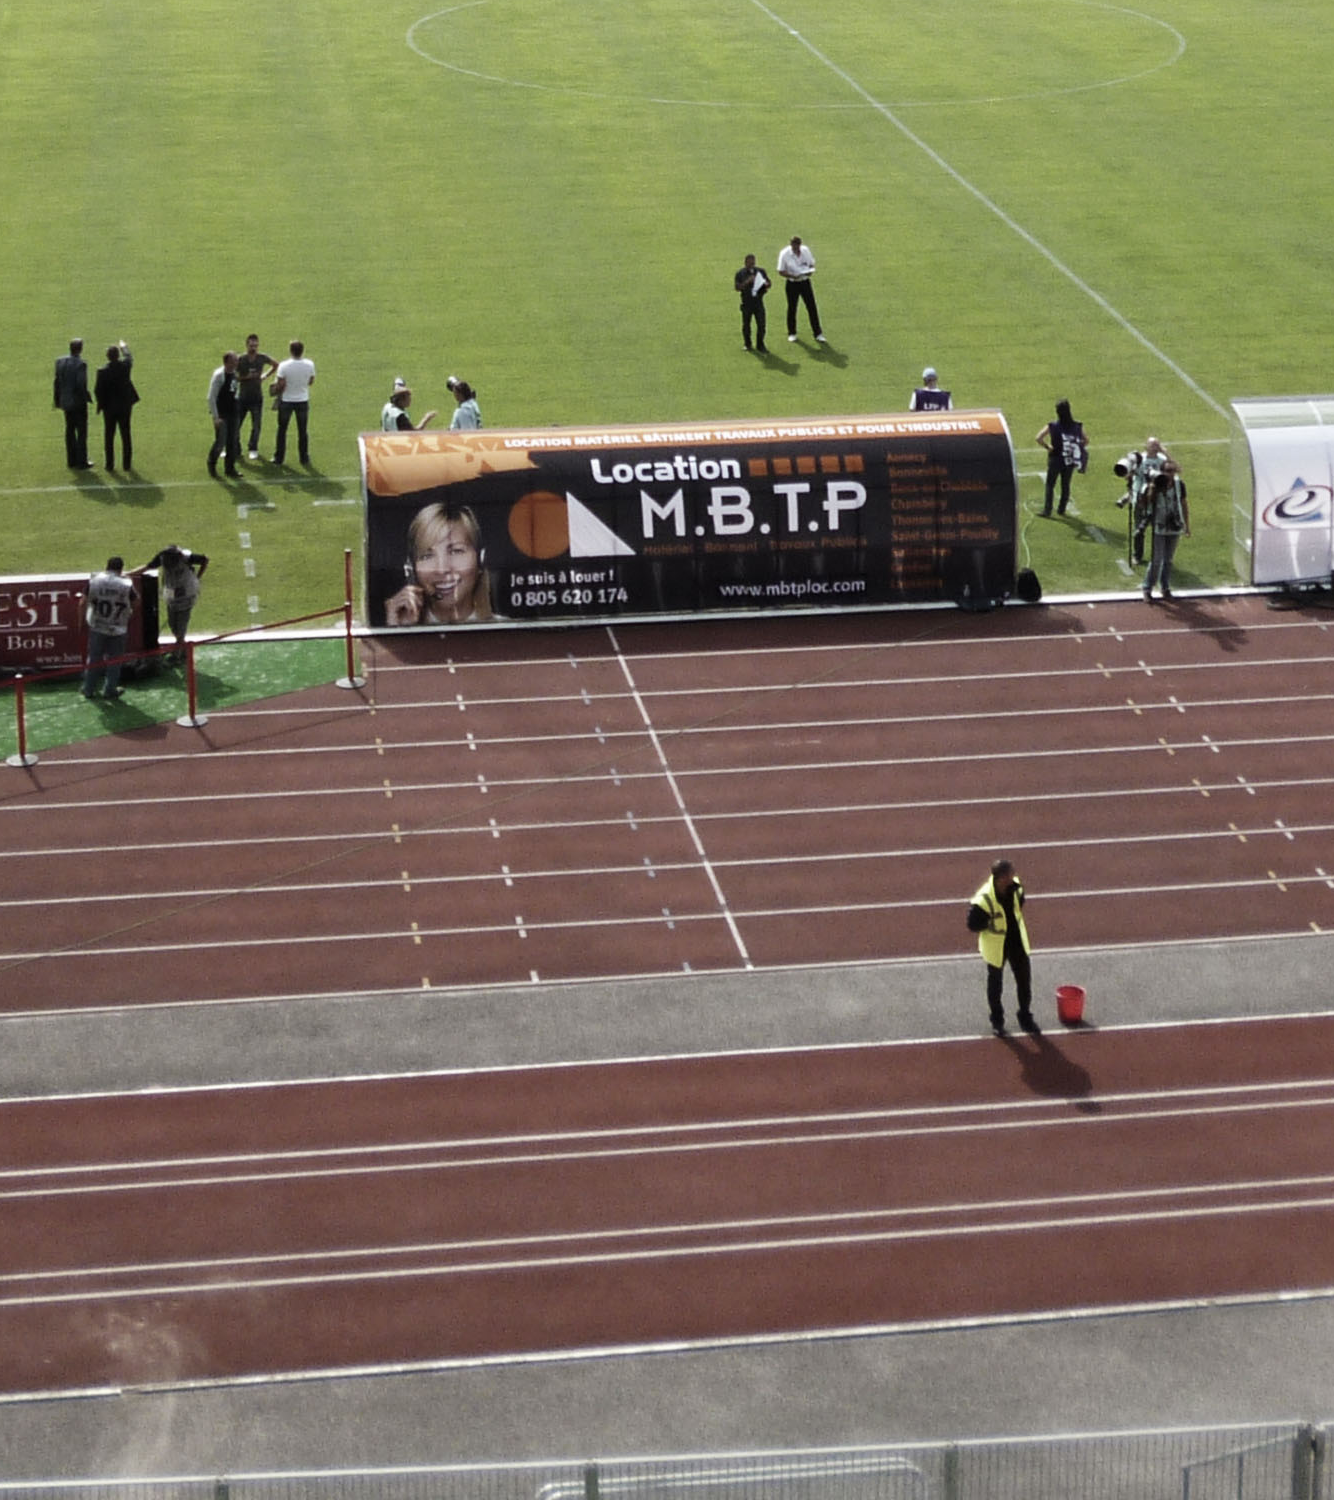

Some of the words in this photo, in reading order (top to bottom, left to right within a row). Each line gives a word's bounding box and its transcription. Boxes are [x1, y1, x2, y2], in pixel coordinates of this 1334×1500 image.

[504, 437, 572, 448] LOCATION
[574, 434, 641, 446] MATÉRIEL
[643, 431, 713, 444] BÂTIMENT
[715, 429, 776, 440] TRAVAUX
[778, 426, 836, 437] PUBLICS
[839, 425, 854, 435] ET
[856, 424, 894, 435] POUR
[897, 420, 982, 432] L'INDUSTRIE
[590, 455, 742, 485] Location
[639, 480, 867, 539] M.B.T.P
[510, 573, 524, 587] Je
[528, 571, 556, 585] suis
[558, 571, 566, 584] à
[570, 569, 606, 584] louer
[511, 592, 522, 607] 0
[525, 590, 557, 607] 805
[561, 589, 593, 605] 620
[597, 587, 628, 604] 174
[719, 579, 866, 598] www.mbtploc.com
[7, 634, 56, 649] Bois
